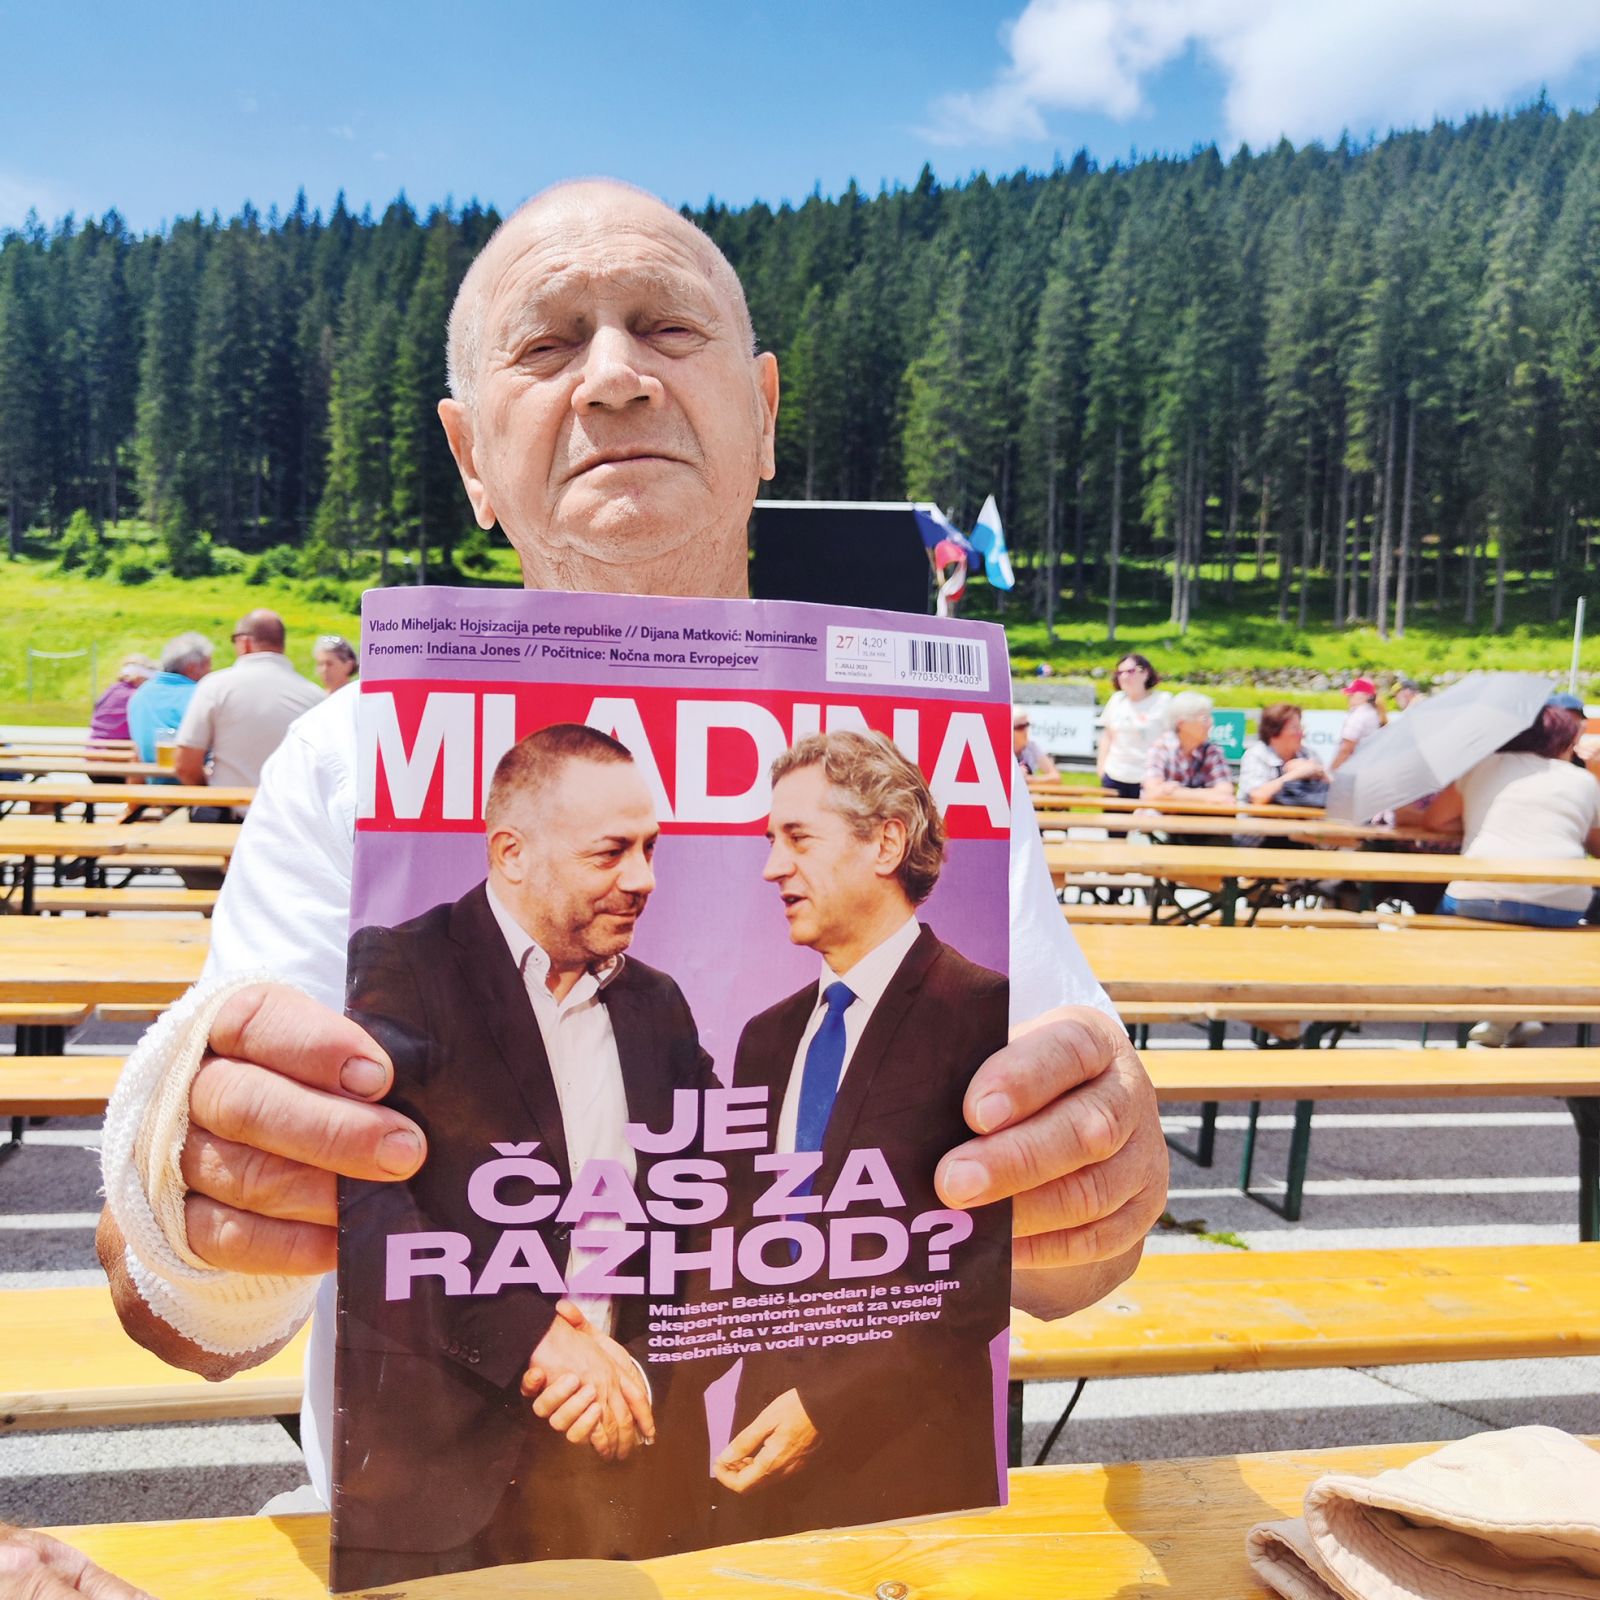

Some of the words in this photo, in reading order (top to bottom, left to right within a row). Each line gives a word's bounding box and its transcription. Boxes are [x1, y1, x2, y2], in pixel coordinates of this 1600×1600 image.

[369, 619, 399, 632] Vlado
[401, 618, 457, 633] Miheljak:
[460, 618, 528, 635] Hojsizacija
[532, 622, 560, 636] pete
[564, 624, 622, 638] republike
[641, 626, 680, 641] Dijana
[683, 628, 742, 642] Matković:
[745, 630, 818, 645] Nominiranke
[835, 635, 854, 649] 27
[369, 643, 423, 655] Fenomen:
[427, 642, 477, 655] Indiana
[480, 643, 520, 656] Jones
[542, 645, 606, 660] Počitnice:
[609, 648, 650, 662] Nočna
[653, 654, 686, 664] mora
[689, 652, 759, 668] Evropejcev
[901, 671, 906, 679] 9
[358, 691, 1011, 828] MADA
[625, 1085, 769, 1154] JE
[467, 1142, 727, 1225] ČAS
[752, 1147, 907, 1217] ZA
[385, 1209, 974, 1302] RAZHOD?
[648, 1300, 729, 1317] Minister
[732, 1293, 786, 1309] Bešič
[788, 1288, 868, 1304] Loredan
[870, 1285, 887, 1299] je
[890, 1286, 901, 1295] s
[904, 1279, 960, 1294] svojim
[648, 1308, 800, 1332] eksperimentom
[803, 1301, 865, 1317] enkrat
[867, 1299, 889, 1312] za
[891, 1294, 942, 1309] vselej
[648, 1329, 726, 1348] dokazal,
[729, 1326, 754, 1340] da
[756, 1326, 769, 1337] v
[771, 1317, 864, 1335] zdravstvu
[867, 1310, 941, 1326] krepitev
[648, 1342, 762, 1363] zasebništva
[765, 1335, 805, 1350] vodi
[807, 1335, 819, 1346] v
[822, 1328, 894, 1346] pogubo
